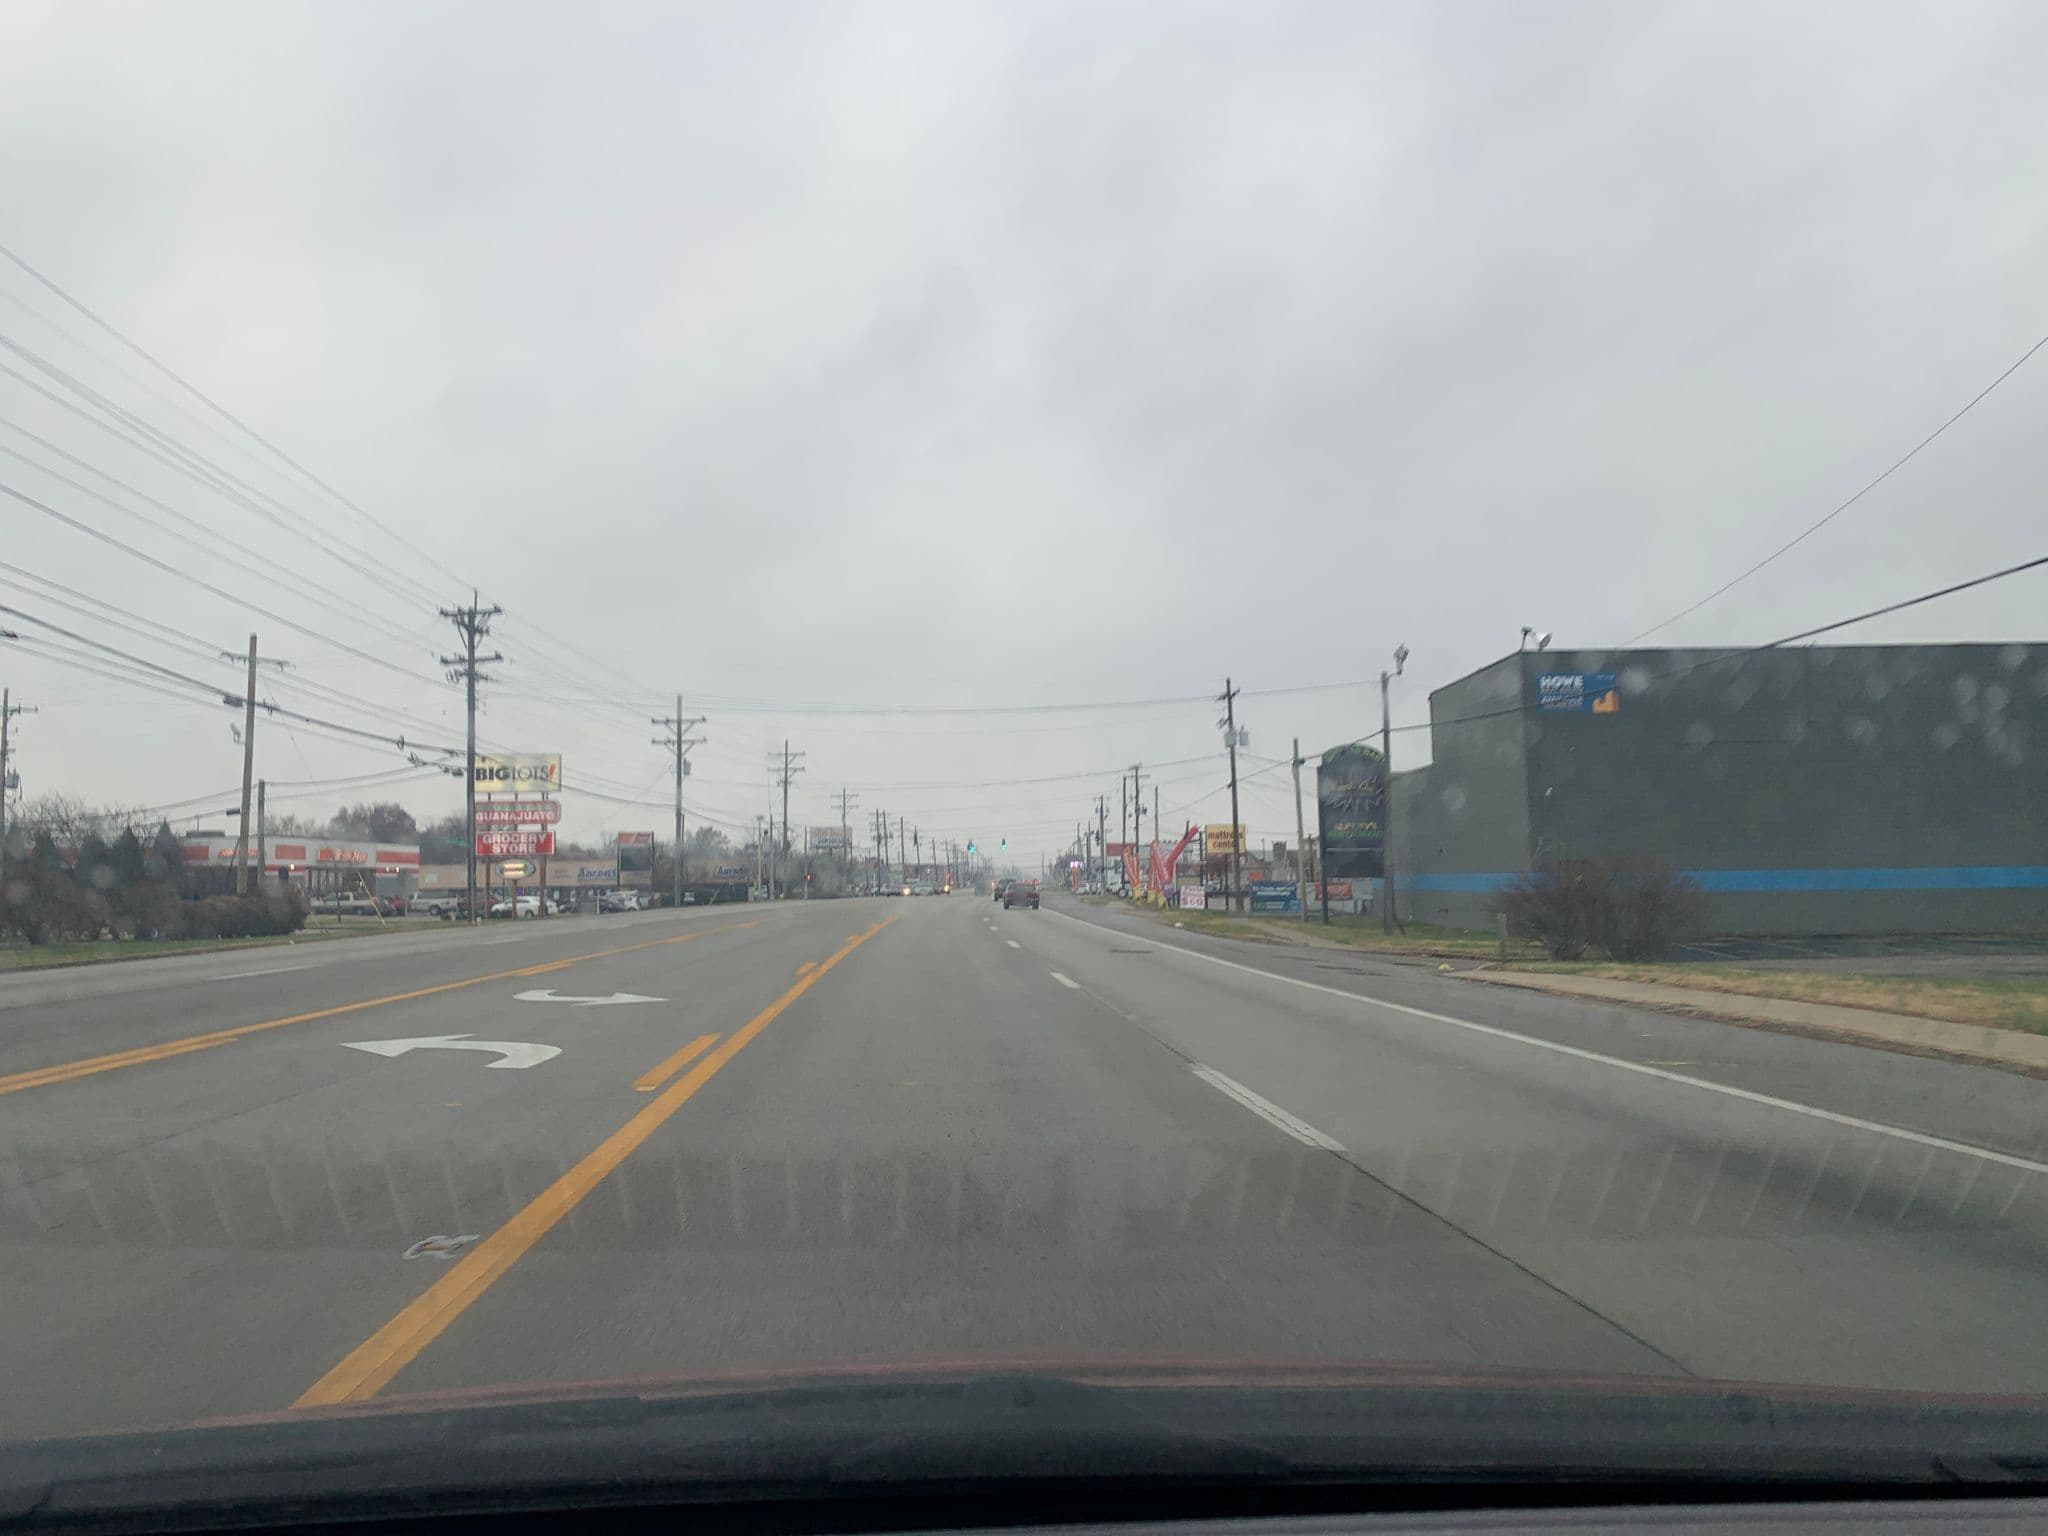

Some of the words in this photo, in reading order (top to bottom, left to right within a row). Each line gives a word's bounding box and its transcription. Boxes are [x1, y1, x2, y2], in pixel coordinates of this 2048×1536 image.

[475, 766, 510, 782] BIG
[475, 811, 555, 823] GUANAJUATO
[482, 834, 547, 845] GROCERY
[1207, 830, 1244, 840] mattres
[492, 844, 538, 854] STORE
[1213, 840, 1238, 849] cente
